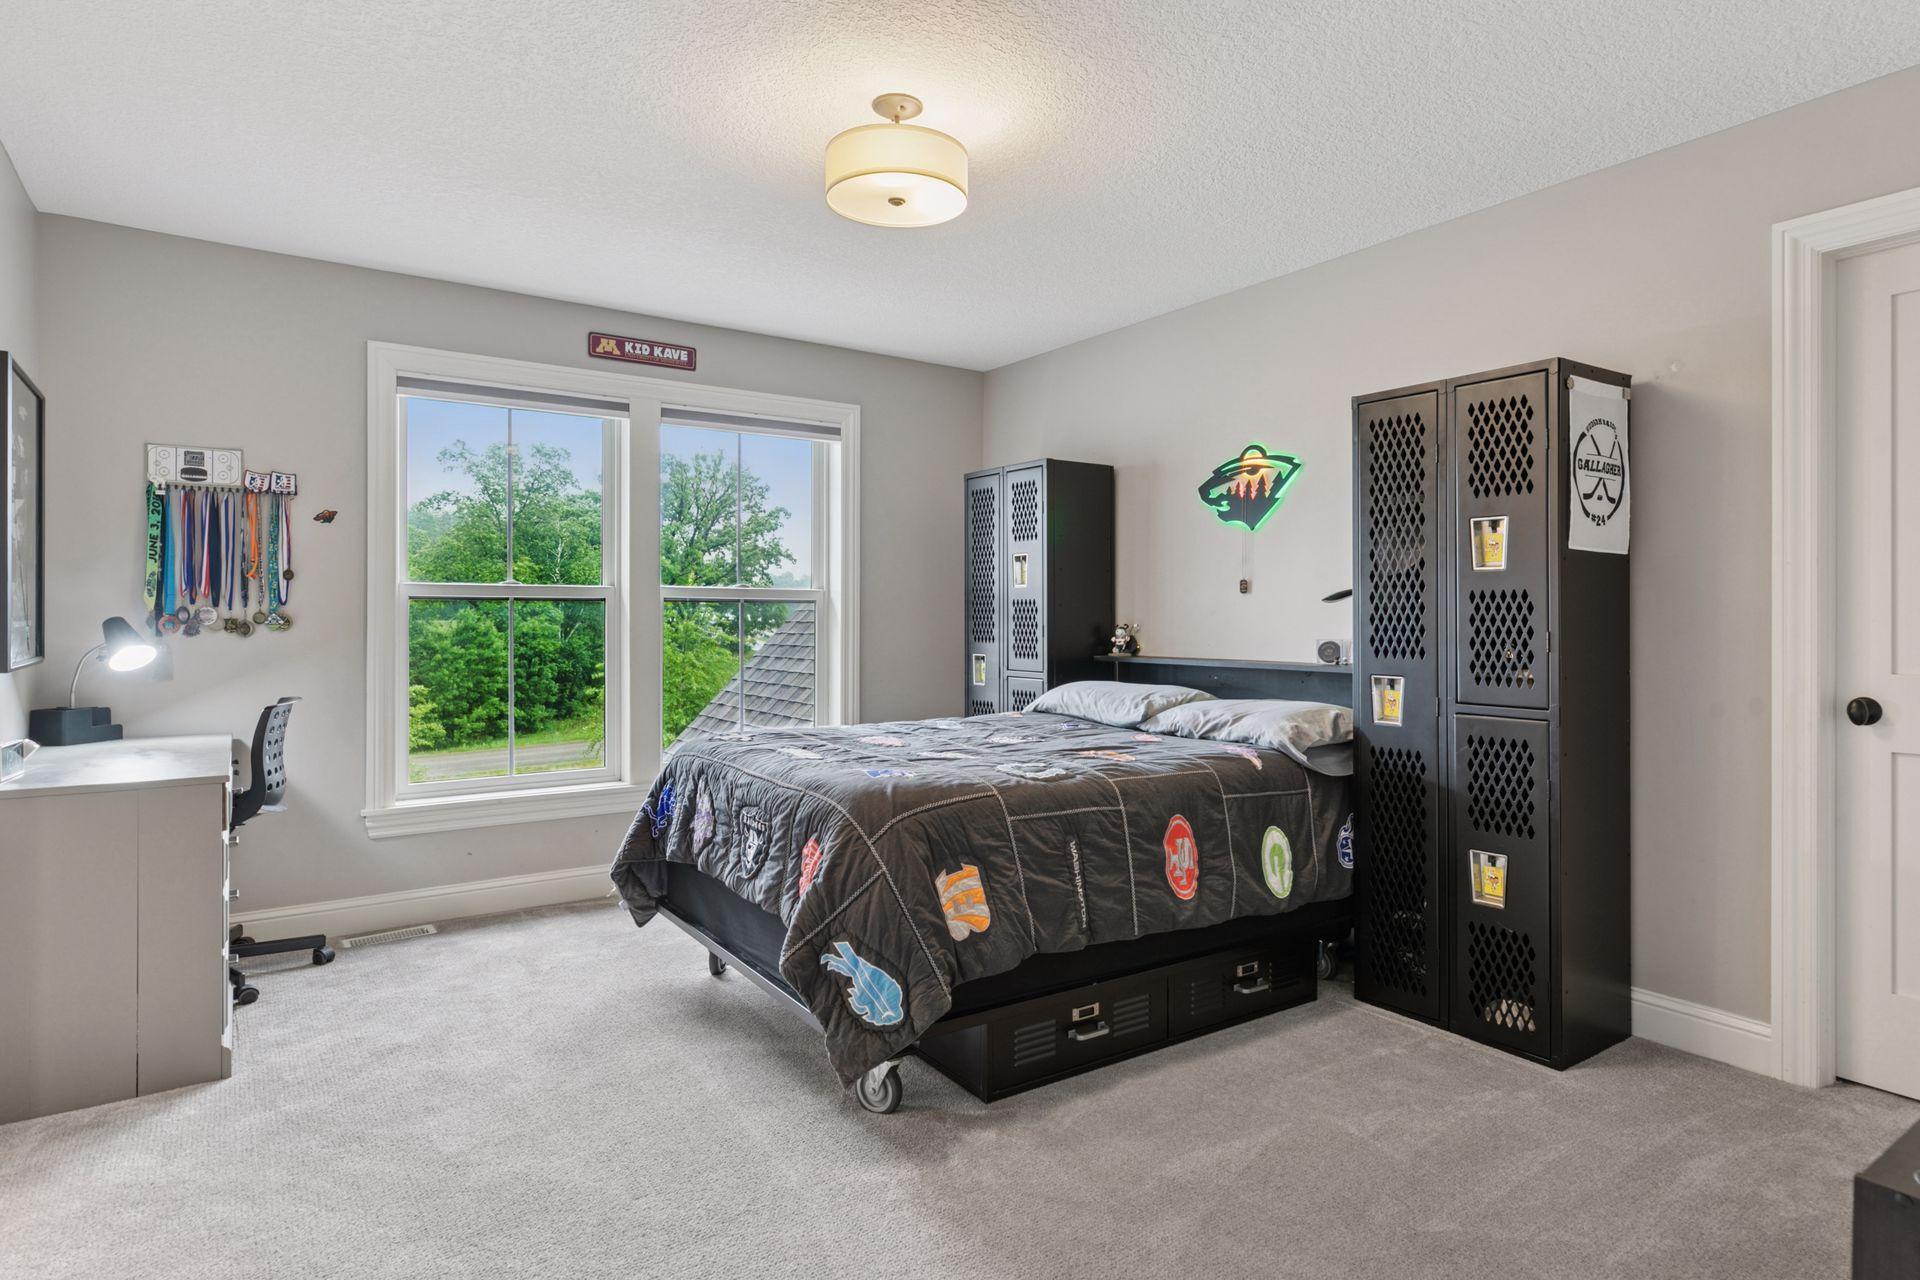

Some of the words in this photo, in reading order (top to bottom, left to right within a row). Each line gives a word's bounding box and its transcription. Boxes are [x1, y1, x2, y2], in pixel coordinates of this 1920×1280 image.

[624, 341, 651, 356] KID
[653, 346, 689, 361] KAVE
[1577, 457, 1621, 477] GALLAGHER
[1590, 513, 1606, 527] #24
[148, 533, 158, 564] JUNE
[1069, 839, 1087, 929] WASHINGTON
